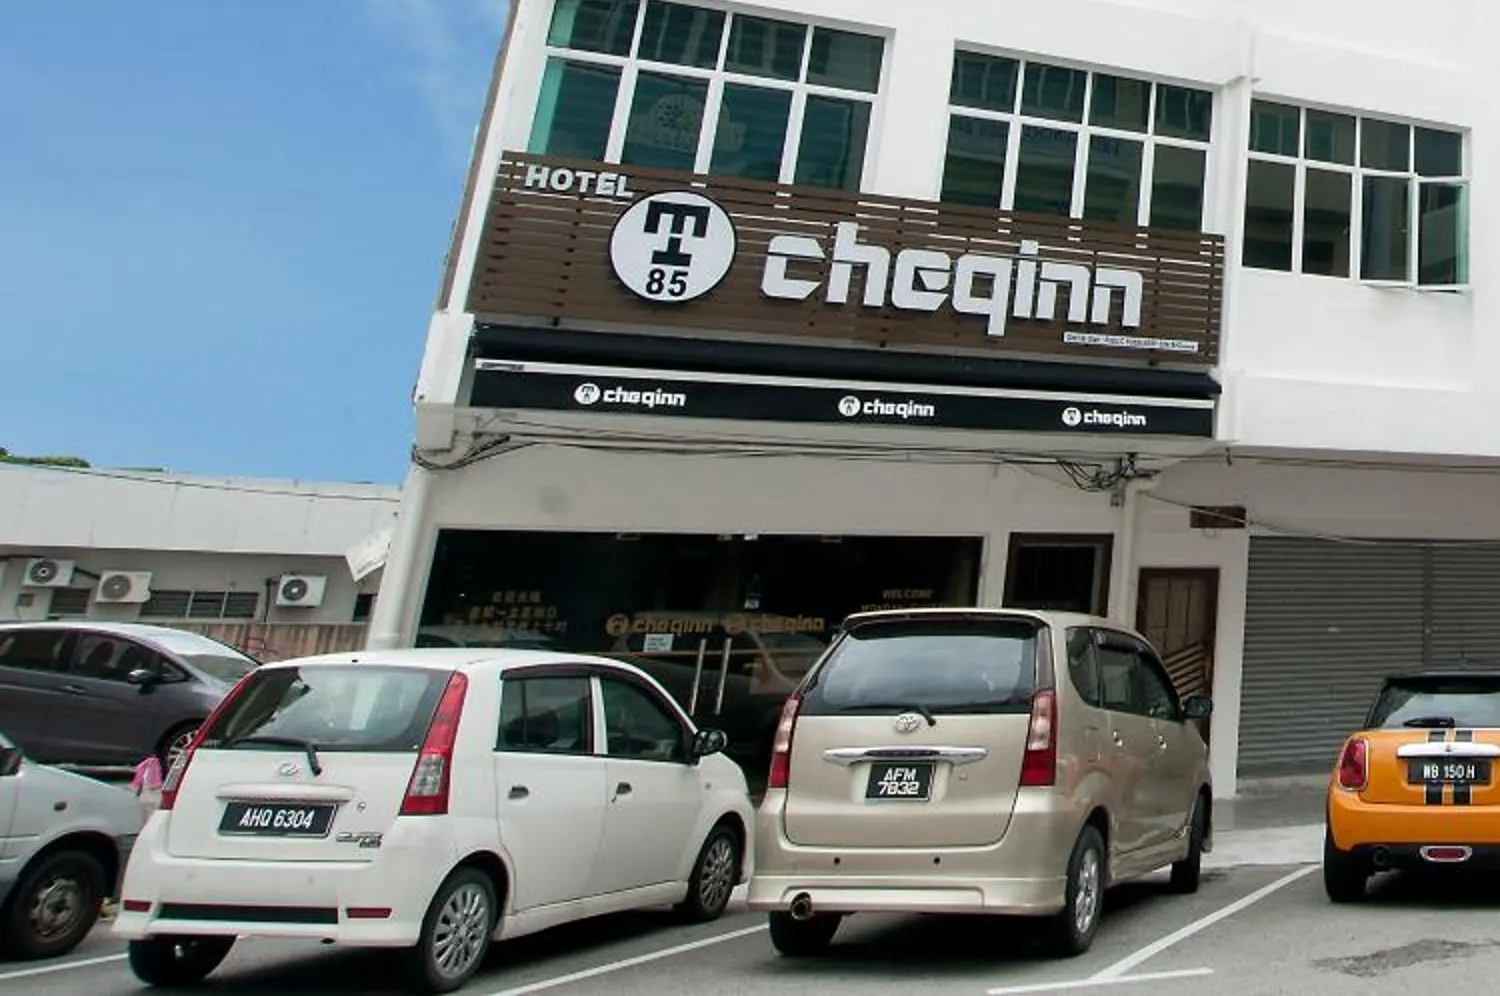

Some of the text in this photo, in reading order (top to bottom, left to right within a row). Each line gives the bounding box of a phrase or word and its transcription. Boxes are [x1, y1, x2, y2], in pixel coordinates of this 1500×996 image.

[523, 164, 636, 198] HOTEL
[644, 269, 688, 299] 85
[760, 222, 1142, 335] cheqinn
[603, 387, 686, 408] cheqinn
[863, 396, 935, 421] cheqinn
[1084, 407, 1147, 428] cheqinn
[884, 767, 917, 781] AFM
[1424, 764, 1439, 779] WB
[239, 808, 316, 829] AHQ 6304
